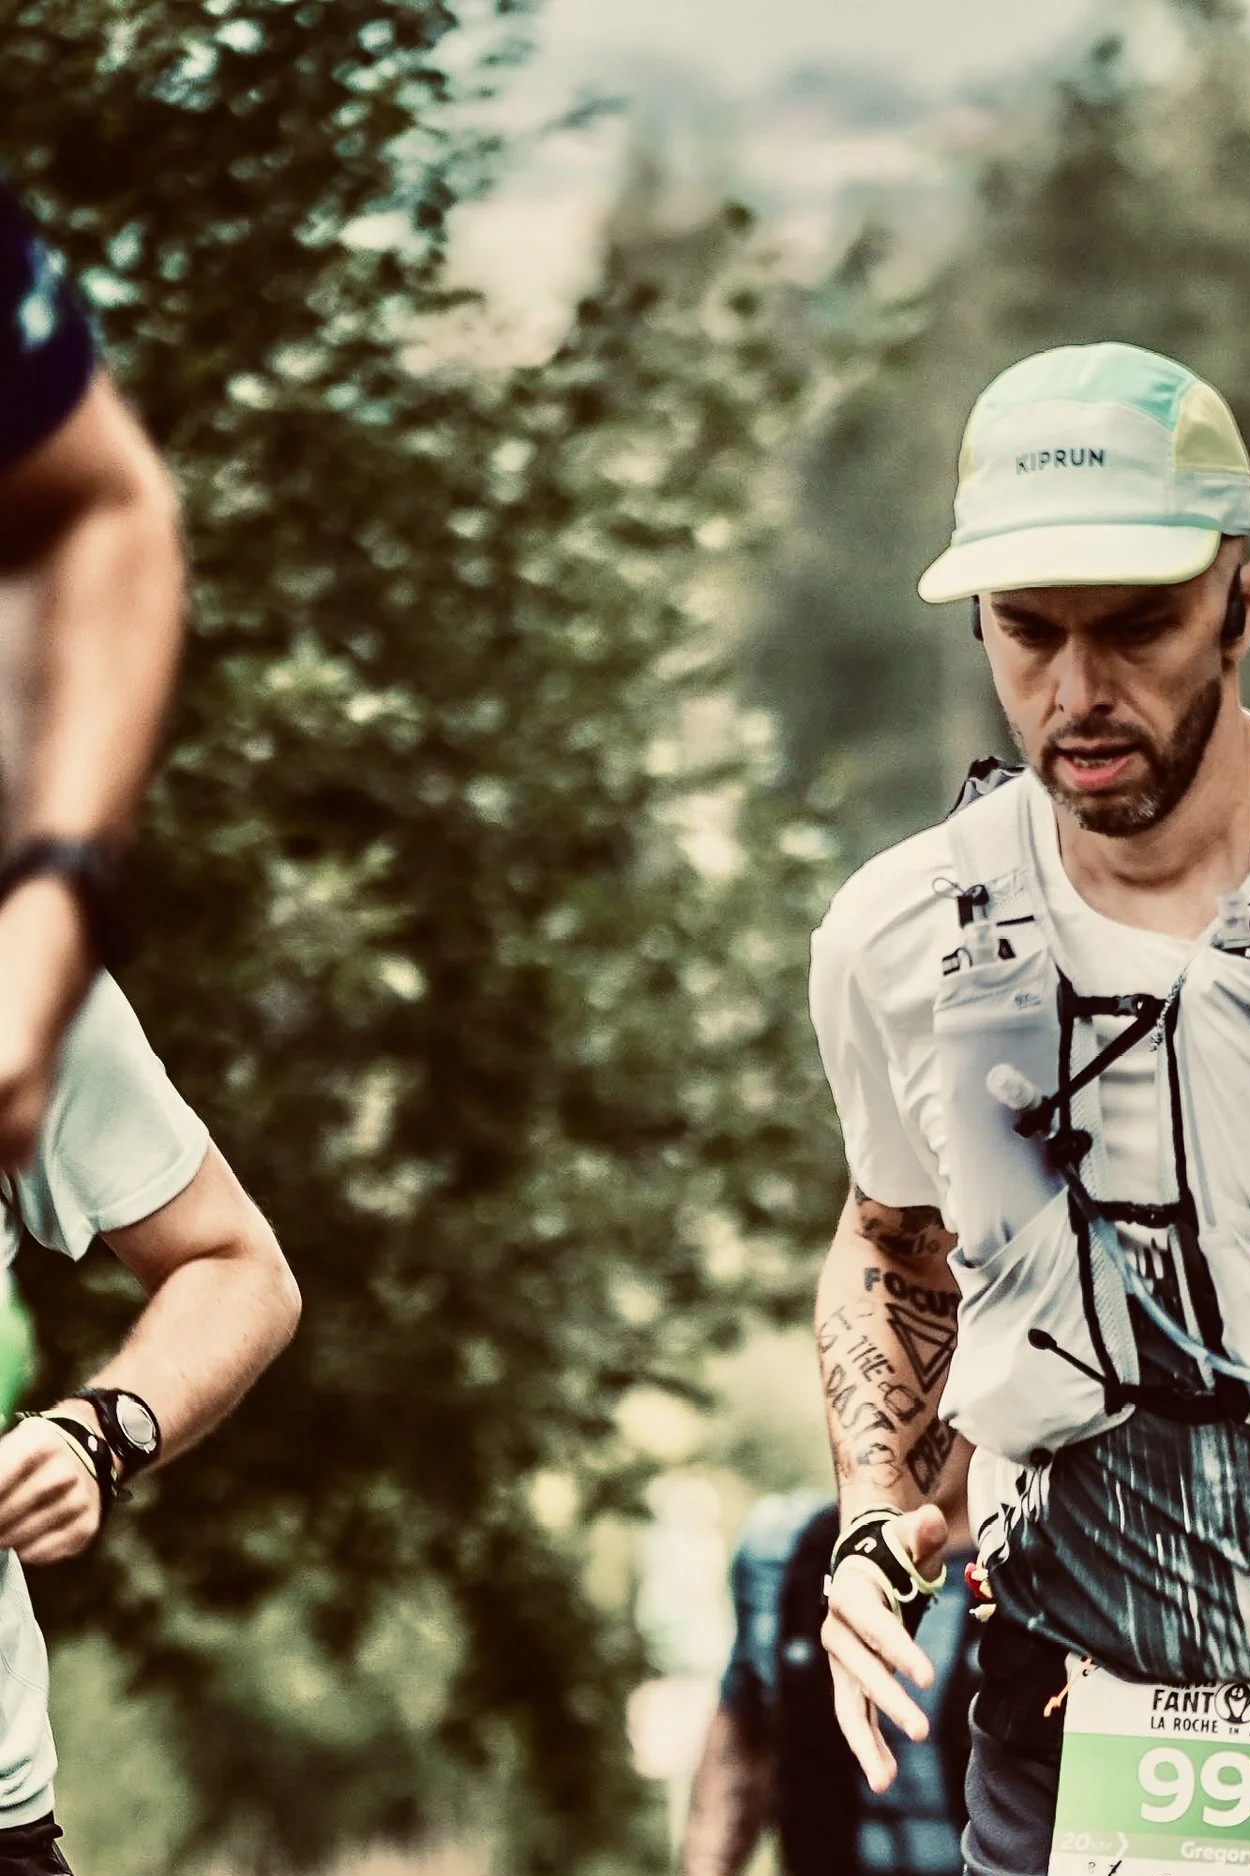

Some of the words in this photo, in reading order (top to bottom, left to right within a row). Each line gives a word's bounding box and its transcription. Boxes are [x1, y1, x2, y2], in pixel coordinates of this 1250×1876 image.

[1015, 448, 1106, 475] KIPRUN
[1150, 1716, 1165, 1730] LA
[1173, 1717, 1219, 1734] ROCHE
[1060, 1831, 1091, 1852] 20
